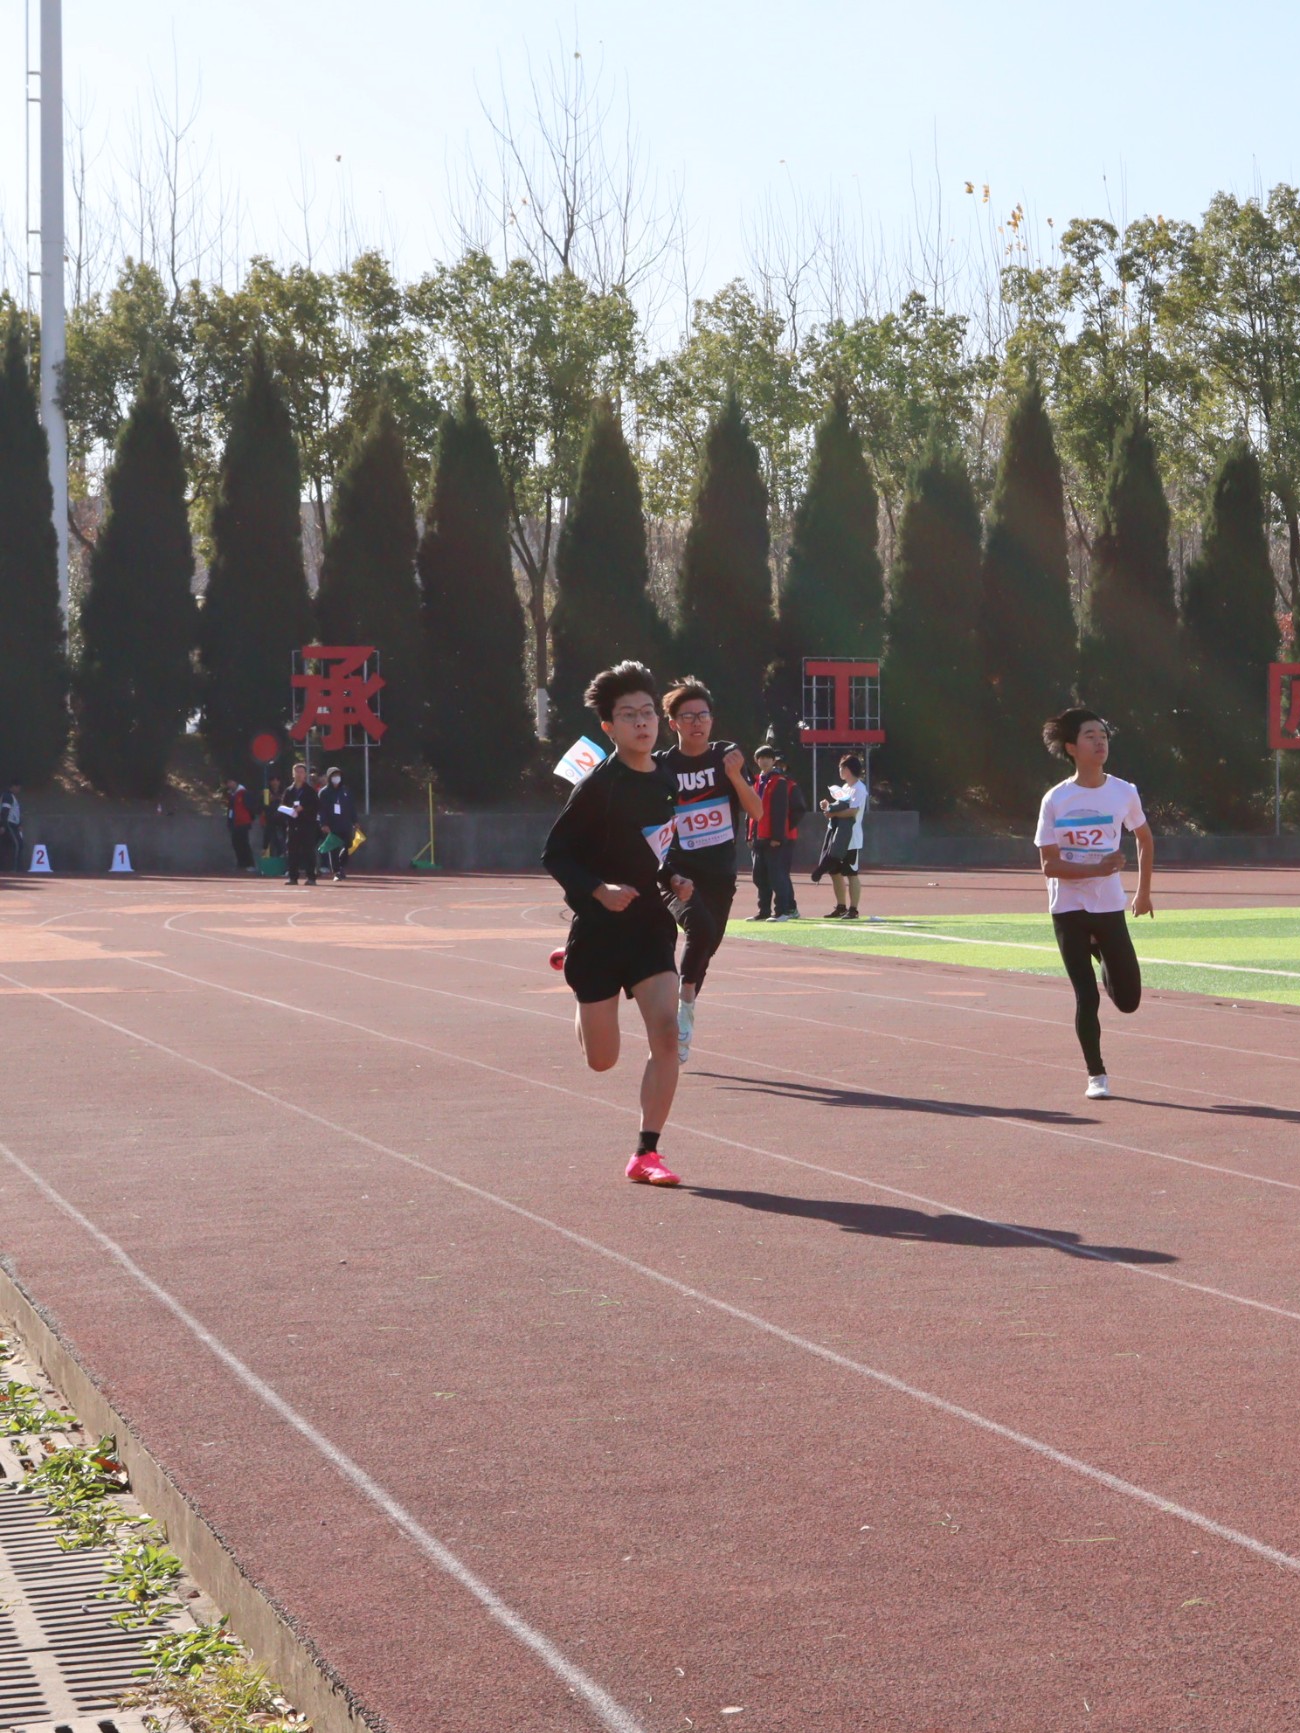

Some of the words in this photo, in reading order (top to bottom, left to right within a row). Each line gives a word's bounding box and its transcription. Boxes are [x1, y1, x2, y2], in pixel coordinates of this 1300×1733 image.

[289, 645, 388, 751] 承
[801, 661, 886, 743] 工
[676, 767, 716, 792] JUST
[682, 810, 723, 832] 199
[1063, 829, 1104, 847] 152
[36, 849, 45, 865] 2
[118, 850, 125, 865] 1
